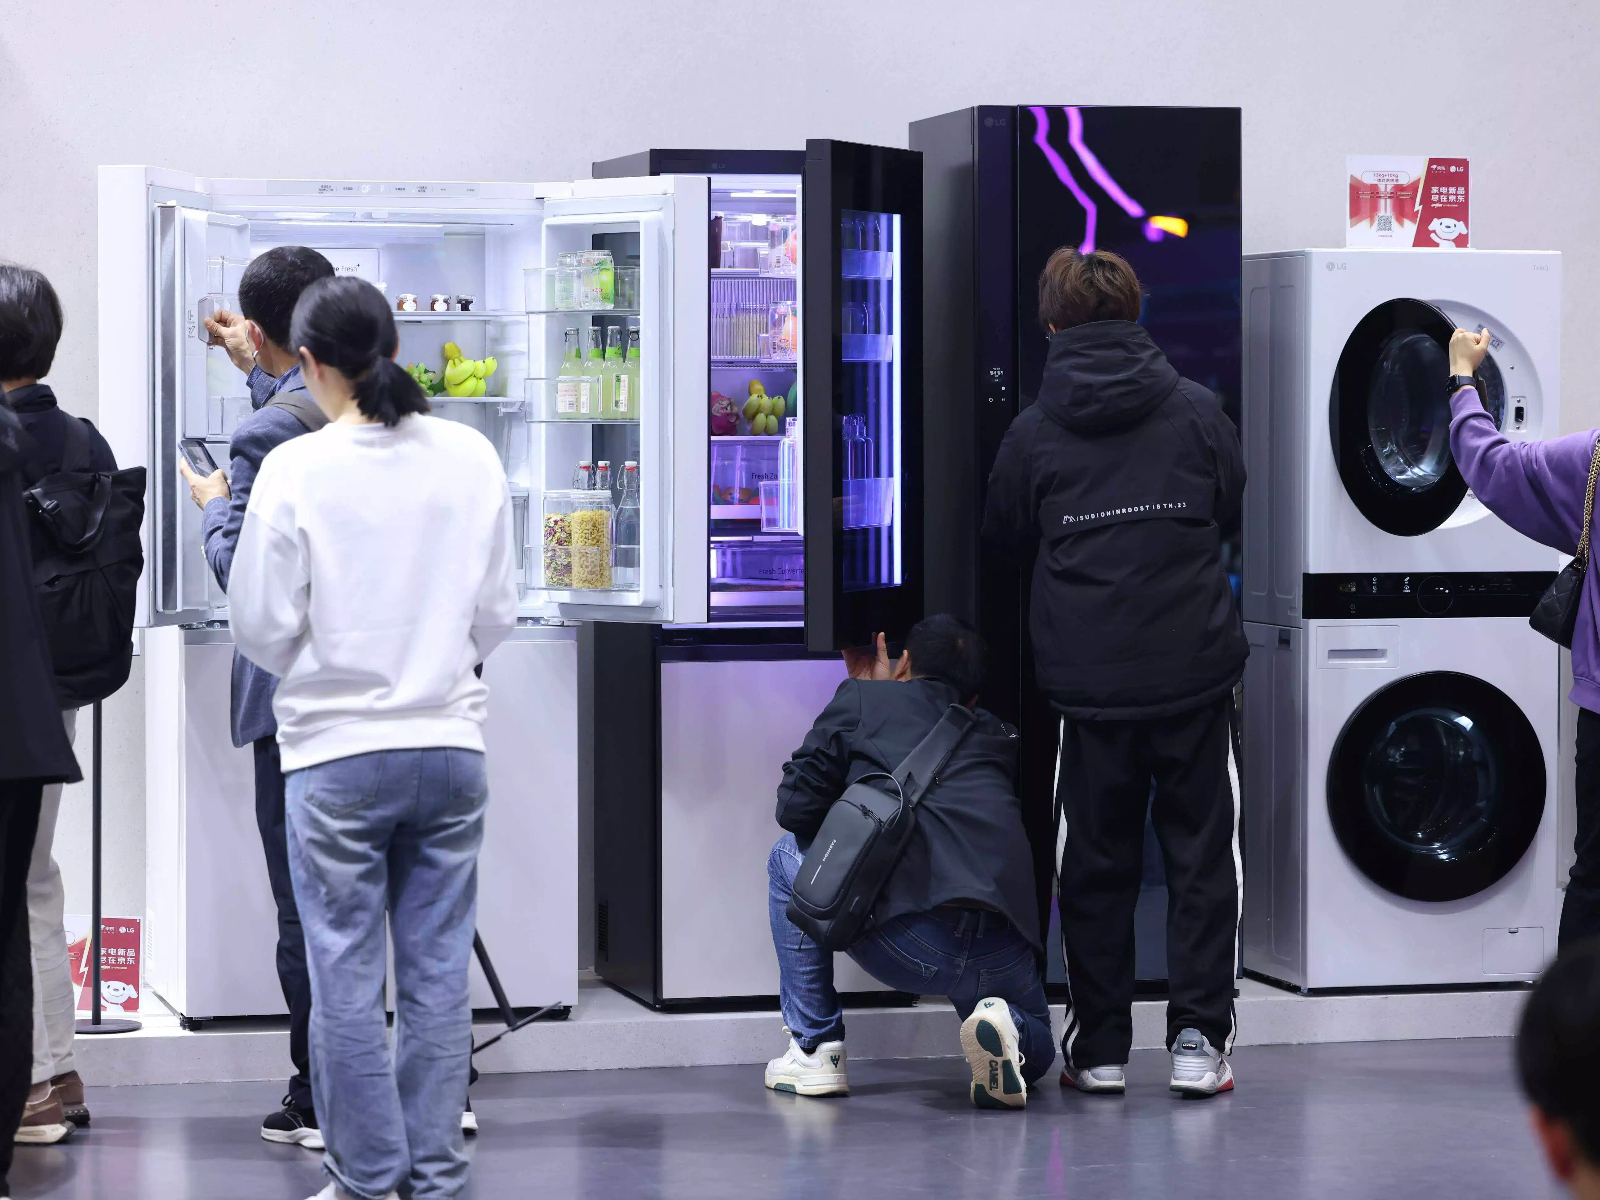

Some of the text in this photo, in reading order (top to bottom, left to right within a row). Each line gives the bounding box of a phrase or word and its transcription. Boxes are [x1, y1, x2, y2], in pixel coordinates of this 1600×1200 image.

[1431, 186, 1466, 195] 家电新品
[1431, 195, 1466, 203] 尽在京东
[1336, 262, 1347, 270] LG
[751, 472, 769, 480] Fresh
[758, 567, 776, 575] Fresh
[989, 1060, 999, 1092] CAMEL
